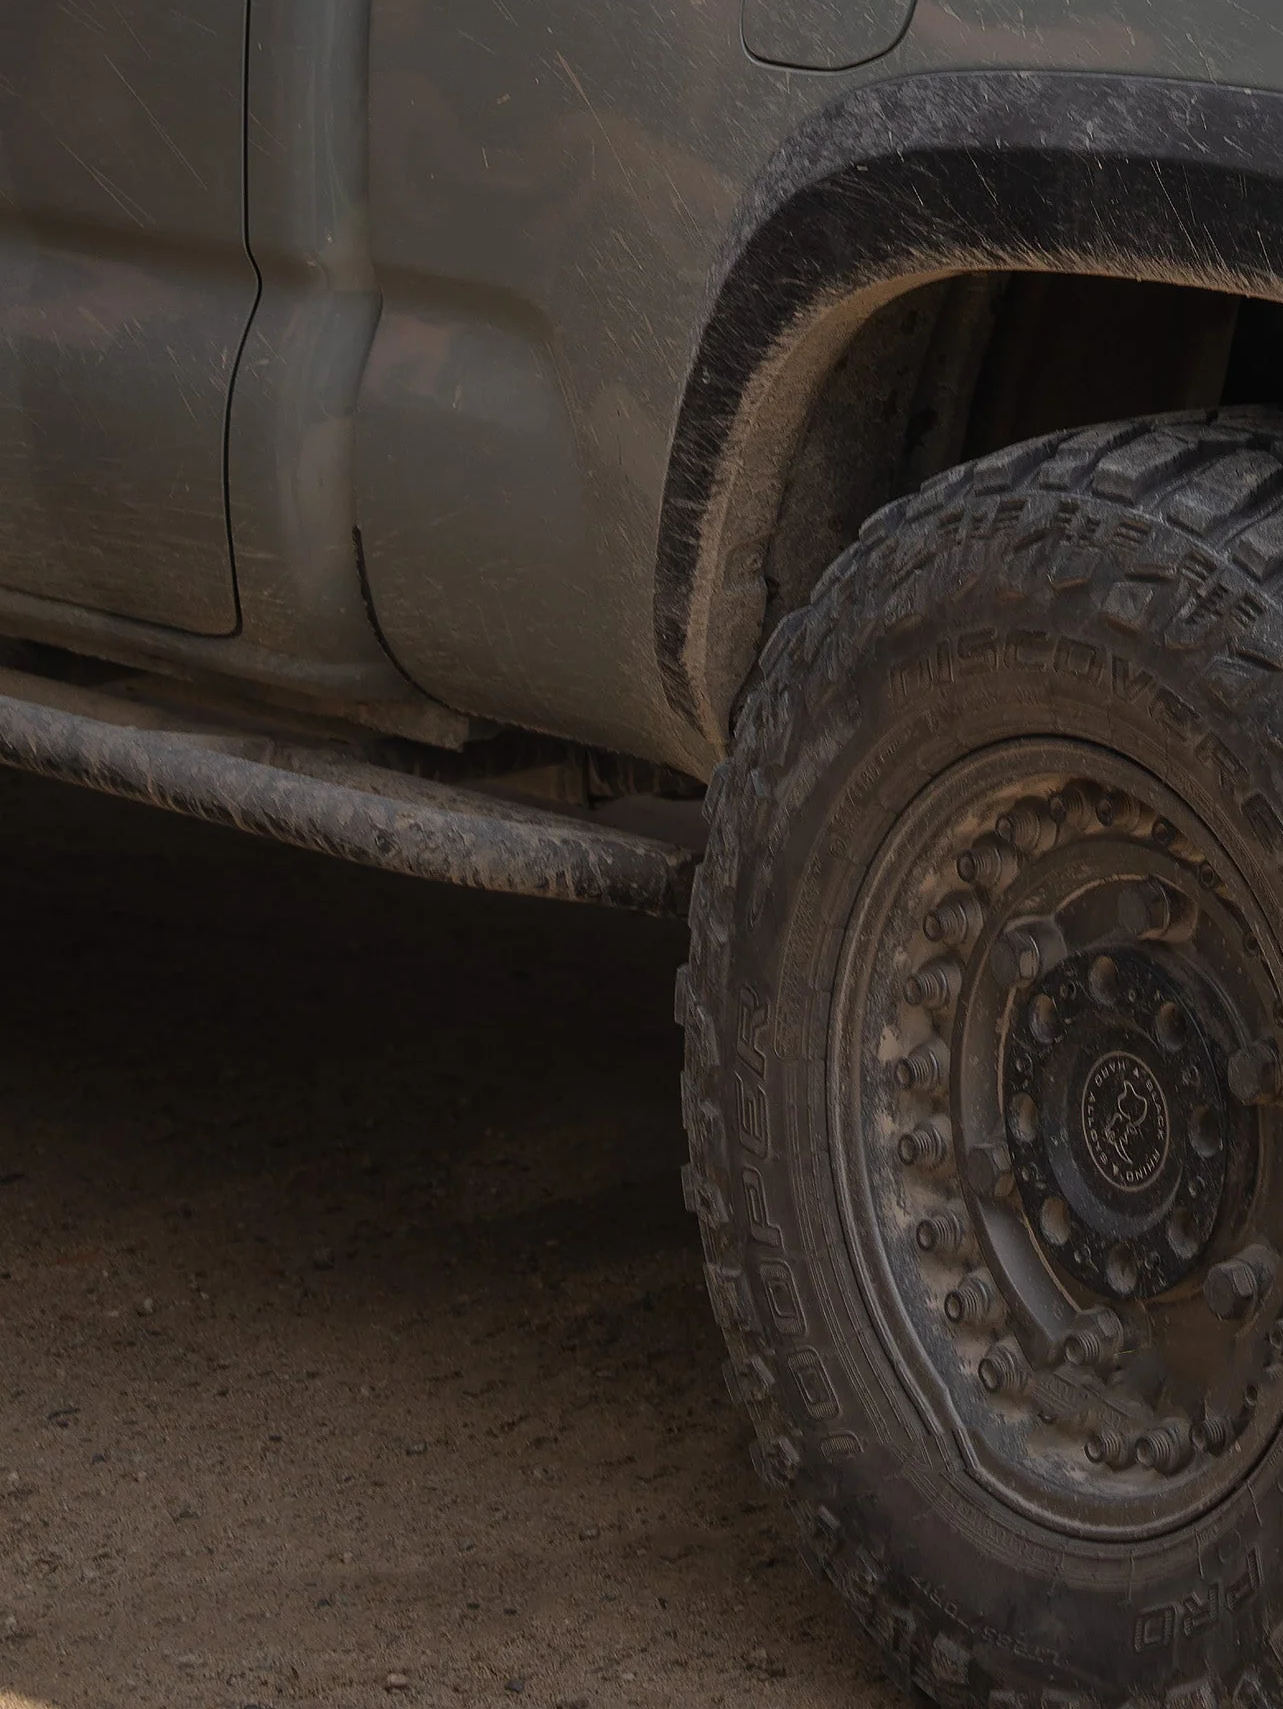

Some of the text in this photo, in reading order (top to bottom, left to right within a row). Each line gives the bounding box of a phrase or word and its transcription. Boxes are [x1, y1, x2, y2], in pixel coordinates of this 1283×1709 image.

[1094, 1059, 1127, 1087] HARD
[1125, 1077, 1167, 1184] BLACK RHINO
